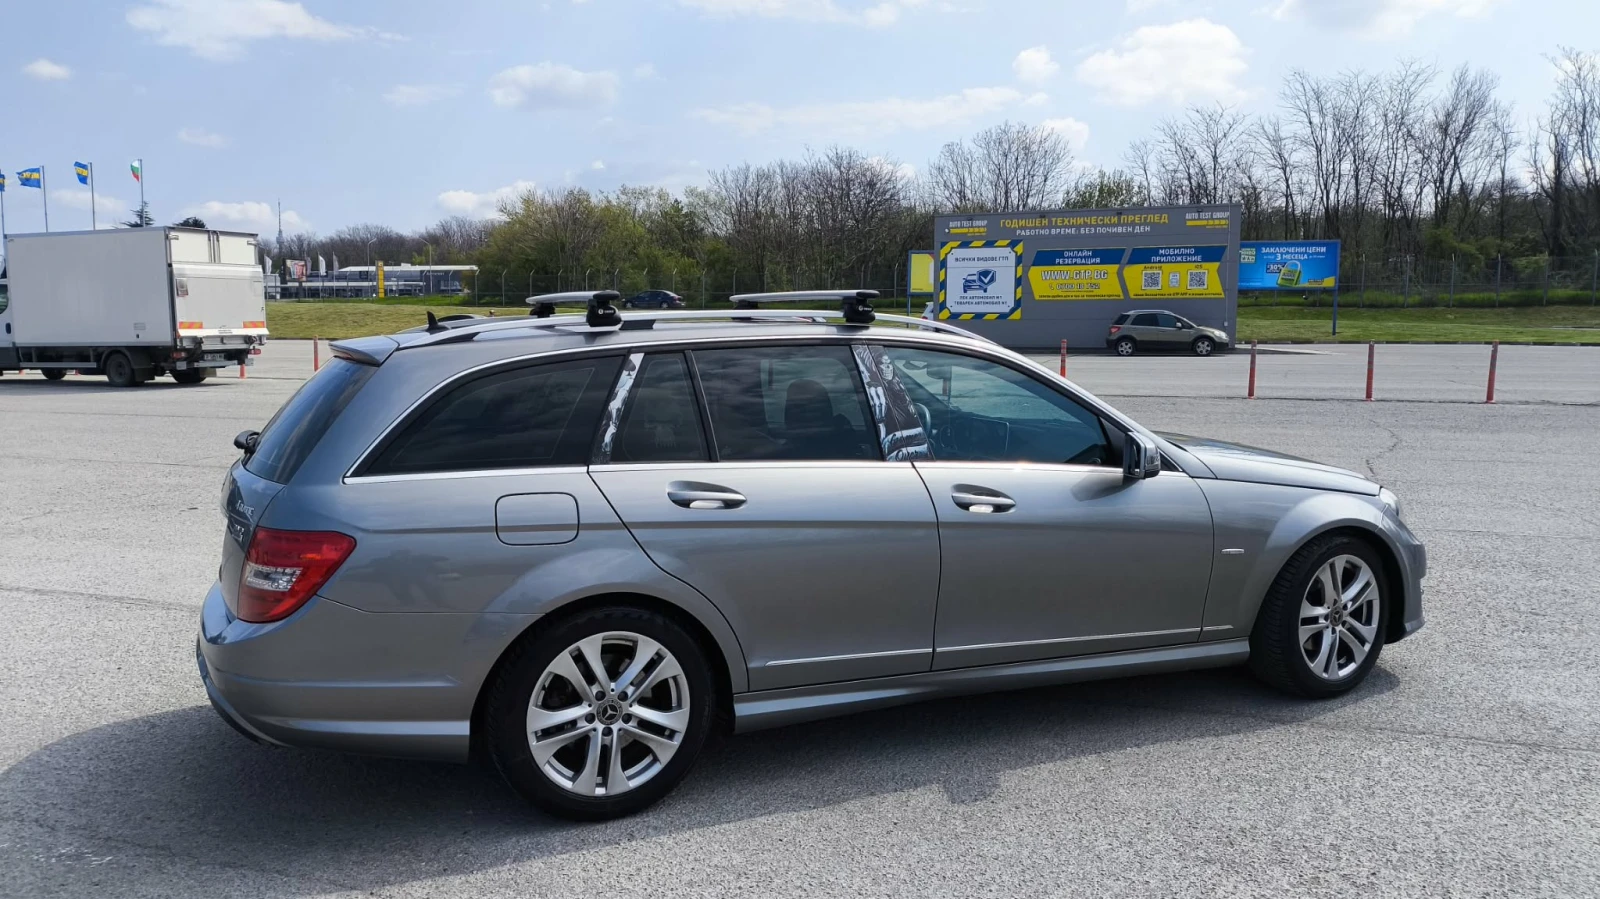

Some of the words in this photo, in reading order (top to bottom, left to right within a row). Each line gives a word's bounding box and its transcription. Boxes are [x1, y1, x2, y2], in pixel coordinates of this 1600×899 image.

[1000, 218, 1048, 228] ГОДИШЕН
[1052, 215, 1118, 225] ТЕХНИЧЕСКИ
[1121, 214, 1168, 224] ПРЕГЛЕД
[1016, 228, 1049, 236] РАБОТНО
[1080, 226, 1095, 234] БЕЗ
[1096, 226, 1132, 234] ПОЧИВЕН
[1134, 225, 1150, 233] ДЕН
[1055, 257, 1101, 265] РЕЗЕРВАЦИЯ
[1151, 255, 1202, 263] ПРИЛОЖЕНИЕ
[1041, 270, 1107, 280] WWW.GTP.BG
